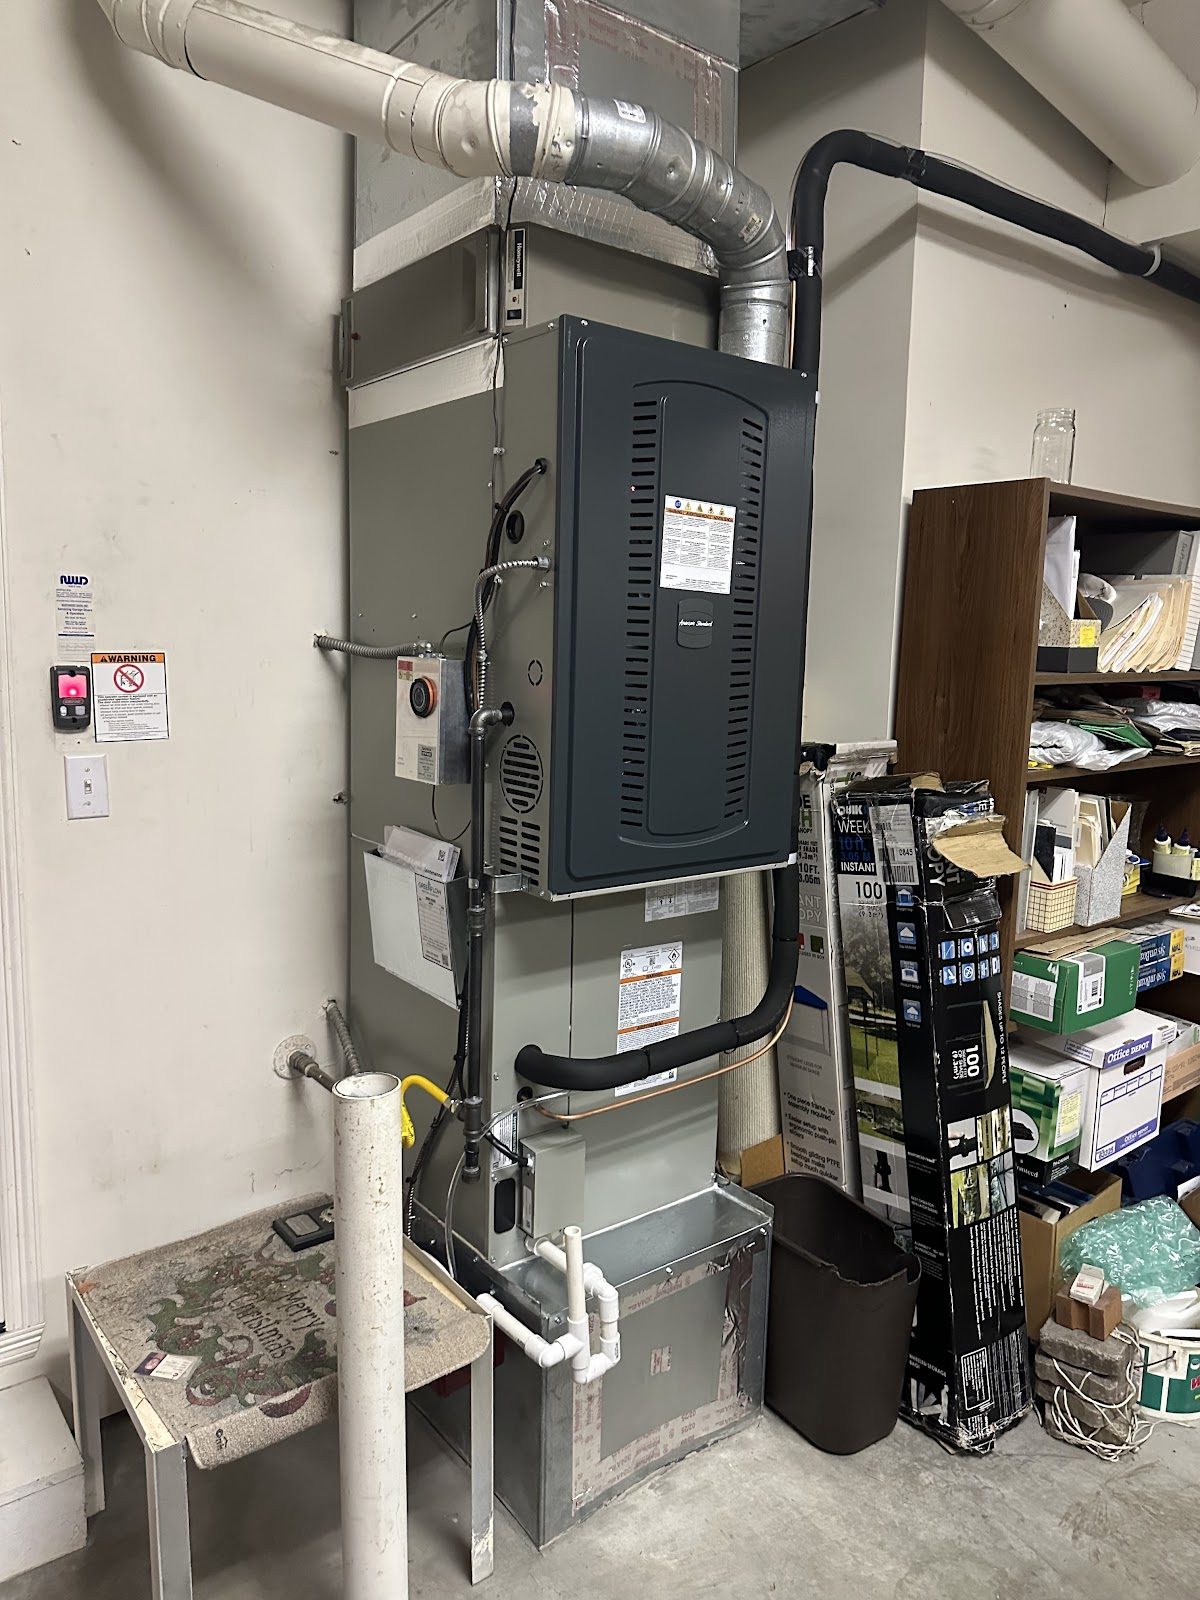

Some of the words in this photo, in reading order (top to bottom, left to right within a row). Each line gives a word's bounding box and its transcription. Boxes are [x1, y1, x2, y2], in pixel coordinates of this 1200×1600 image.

[679, 618, 696, 627] American
[108, 654, 156, 663] WARNING
[837, 804, 863, 816] QUIK
[841, 862, 875, 872] INSTANT
[856, 881, 882, 899] 100
[1107, 1046, 1130, 1064] Office
[1130, 1040, 1150, 1054] DEPOT
[965, 1044, 980, 1078] 100
[826, 1156, 841, 1169] PTFE
[276, 1289, 325, 1332] Merry
[228, 1292, 296, 1360] Christmas
